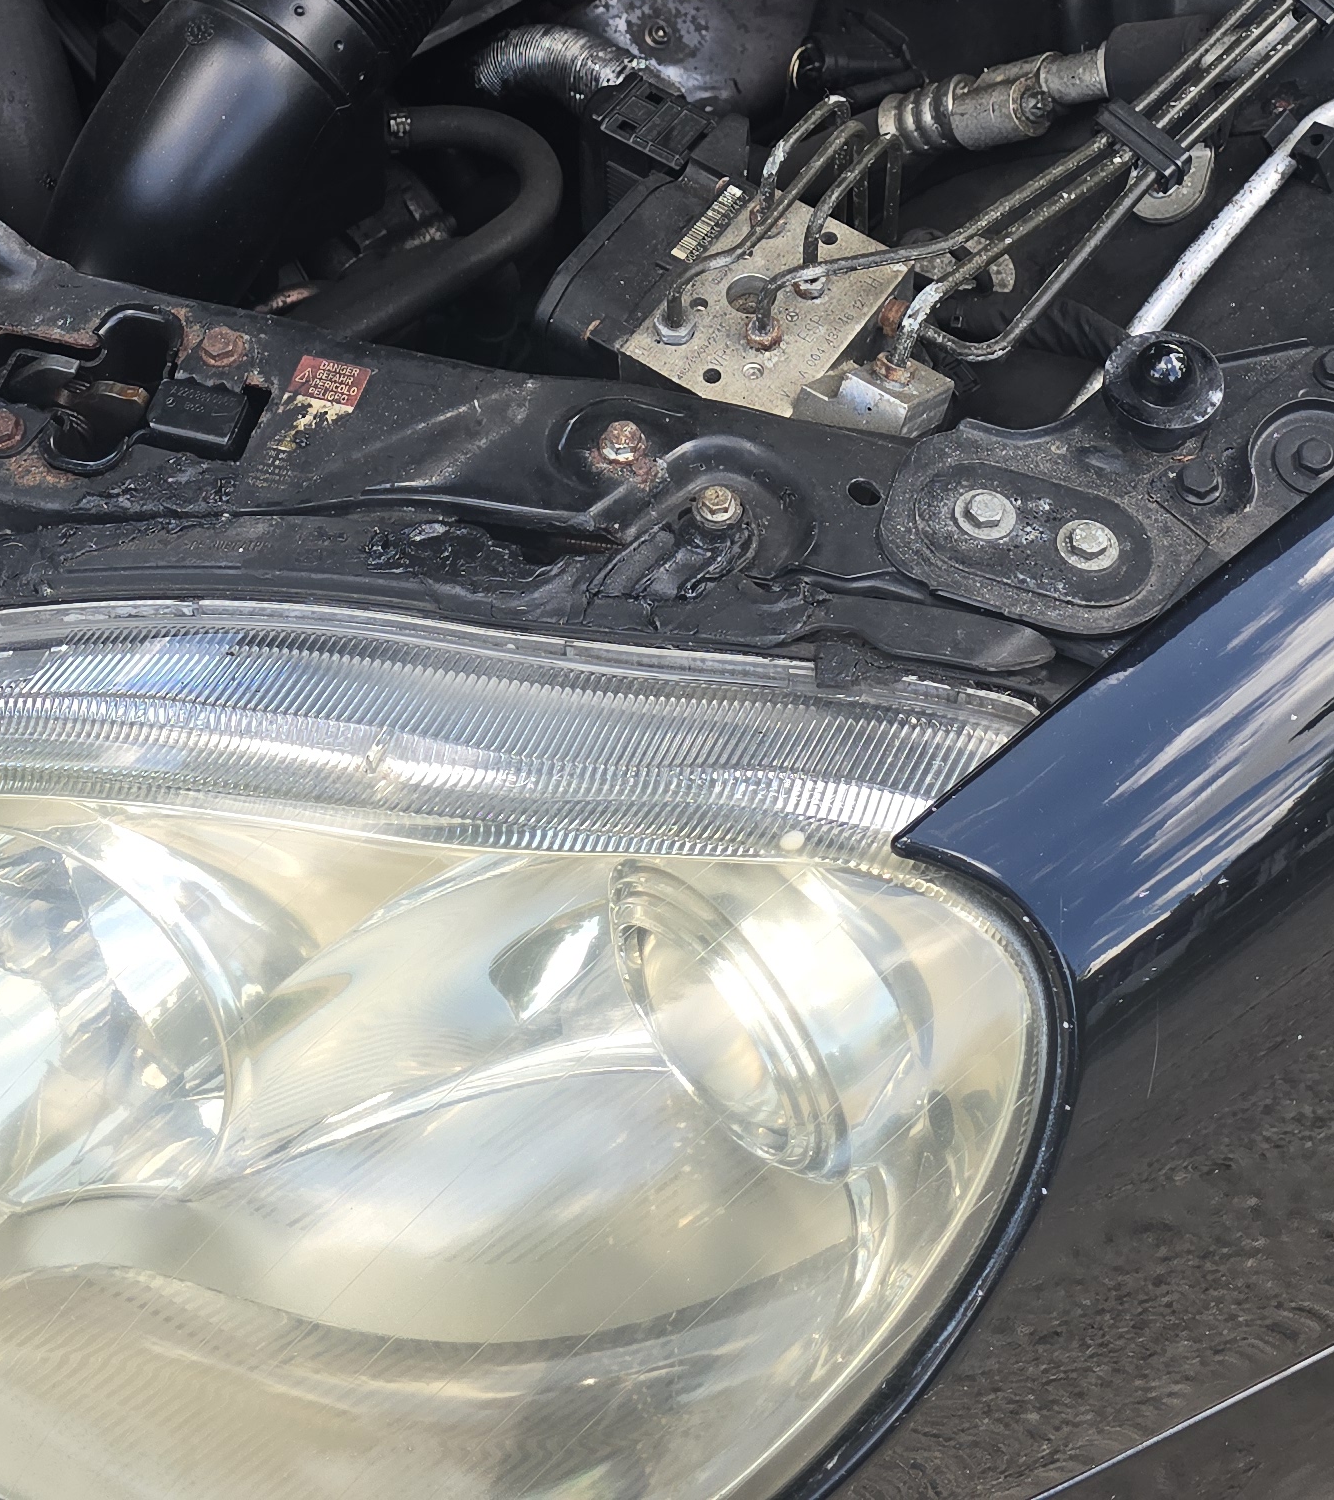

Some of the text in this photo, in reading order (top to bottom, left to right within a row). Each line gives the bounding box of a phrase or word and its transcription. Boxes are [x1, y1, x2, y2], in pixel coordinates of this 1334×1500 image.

[796, 311, 828, 345] ESP
[804, 345, 826, 368] 004
[318, 360, 359, 376] DANGER
[314, 370, 354, 385] GEFAHR
[310, 378, 357, 395] PERICOLO
